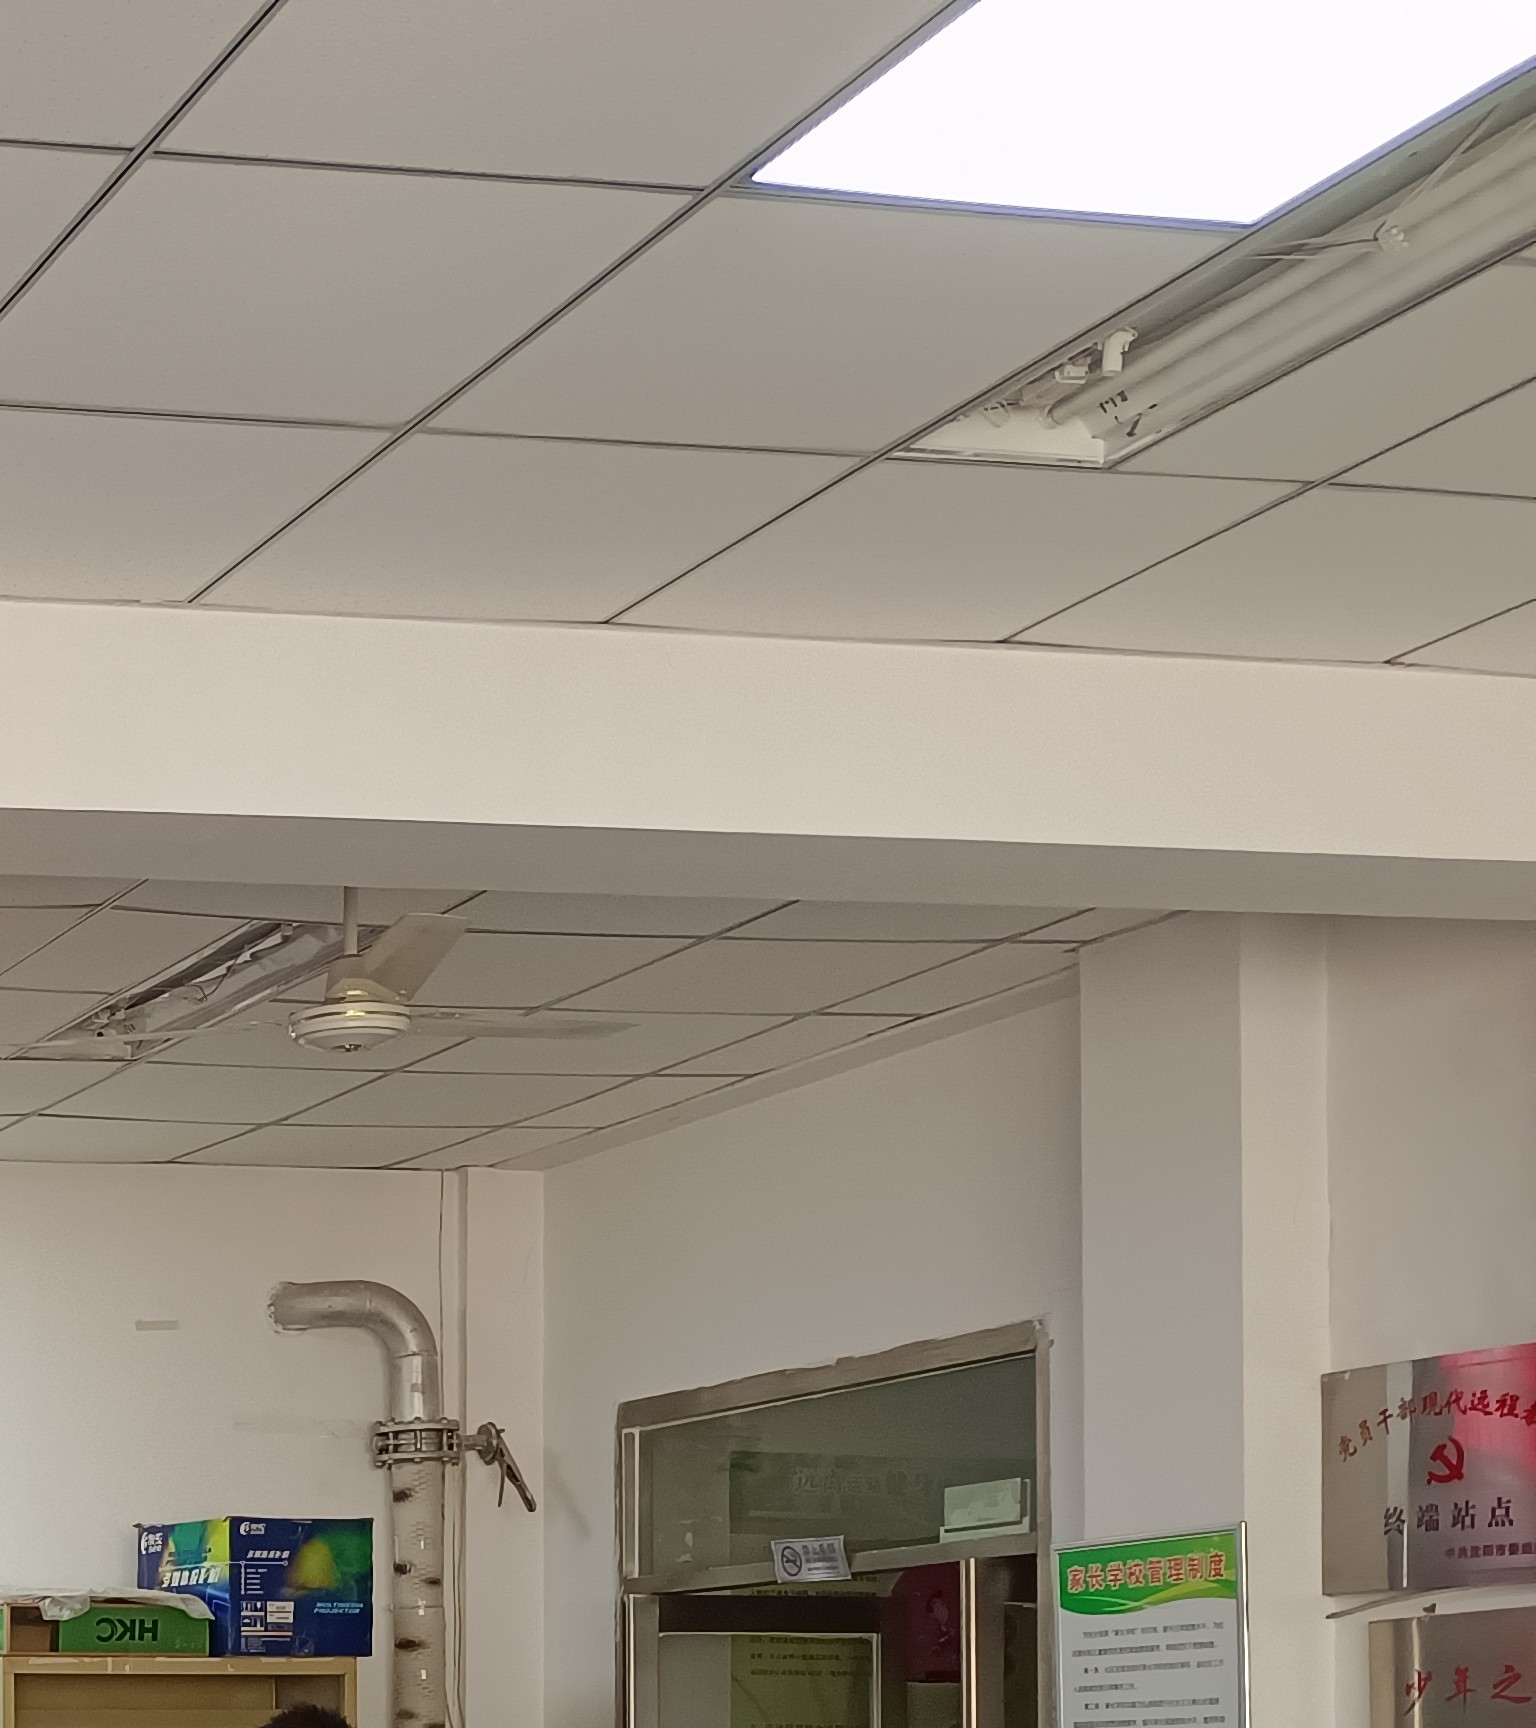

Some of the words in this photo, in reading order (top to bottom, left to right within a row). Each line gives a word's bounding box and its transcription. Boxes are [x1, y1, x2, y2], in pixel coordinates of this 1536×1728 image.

[1383, 1496, 1515, 1536] 终端站点
[1066, 1551, 1226, 1593] 家长学校管理制度
[95, 1617, 159, 1643] HKC
